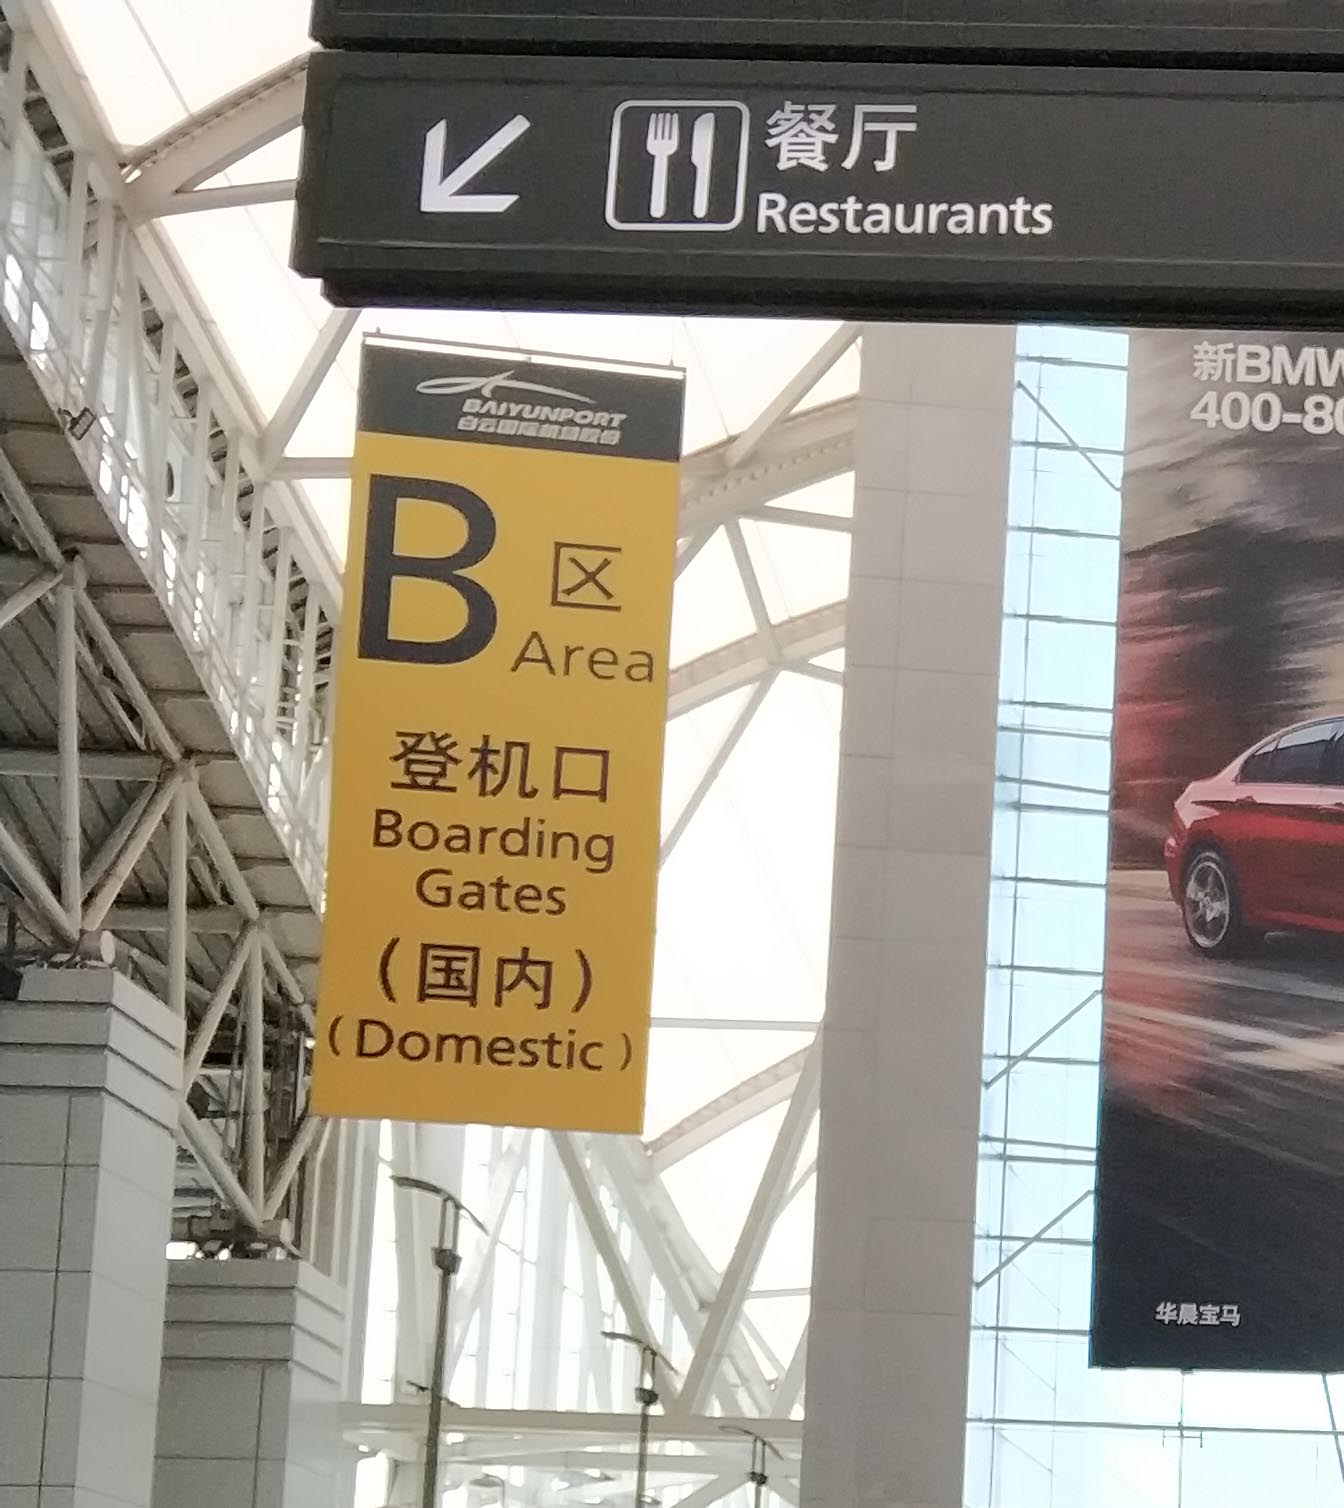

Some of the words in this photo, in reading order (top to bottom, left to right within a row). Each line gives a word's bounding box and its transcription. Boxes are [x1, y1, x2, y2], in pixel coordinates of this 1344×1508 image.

[764, 99, 919, 173] 餐厅
[757, 193, 1053, 236] Restaurants
[463, 399, 627, 428] BAIYUNPORT
[356, 472, 498, 667] B
[550, 540, 622, 612] 区
[511, 632, 654, 684] Area
[390, 730, 611, 804] 登机口
[373, 809, 615, 875] Boarding
[416, 869, 566, 916] Gates
[1156, 1301, 1241, 1328] 华晨宝马
